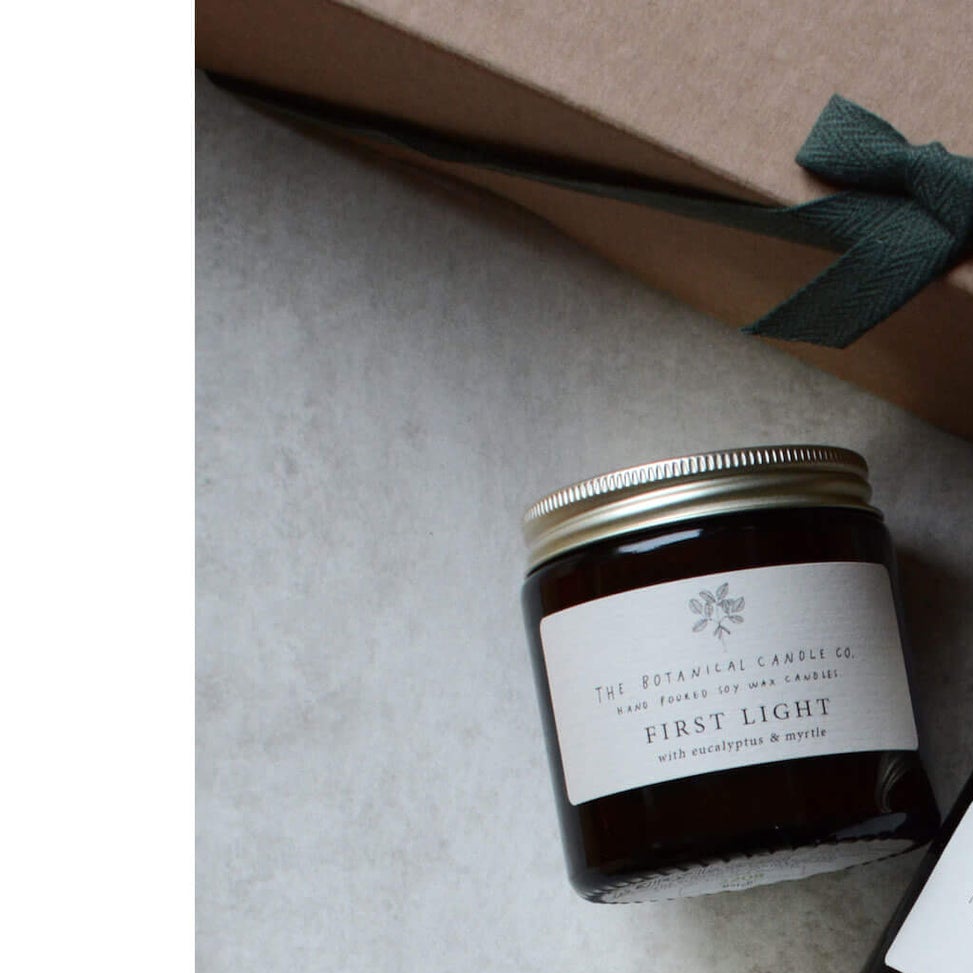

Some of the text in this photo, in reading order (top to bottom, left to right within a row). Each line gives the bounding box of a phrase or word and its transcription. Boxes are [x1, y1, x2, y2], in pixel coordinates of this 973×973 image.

[595, 647, 855, 704] THE BOTANICAL CANDLE CO.
[617, 702, 648, 715] HAND
[719, 684, 739, 695] SOY
[749, 679, 775, 690] WAX
[785, 669, 839, 683] CANDLES
[645, 698, 830, 744] FIRST LIGHT
[658, 727, 826, 763] with eucalyptus & myrtle
